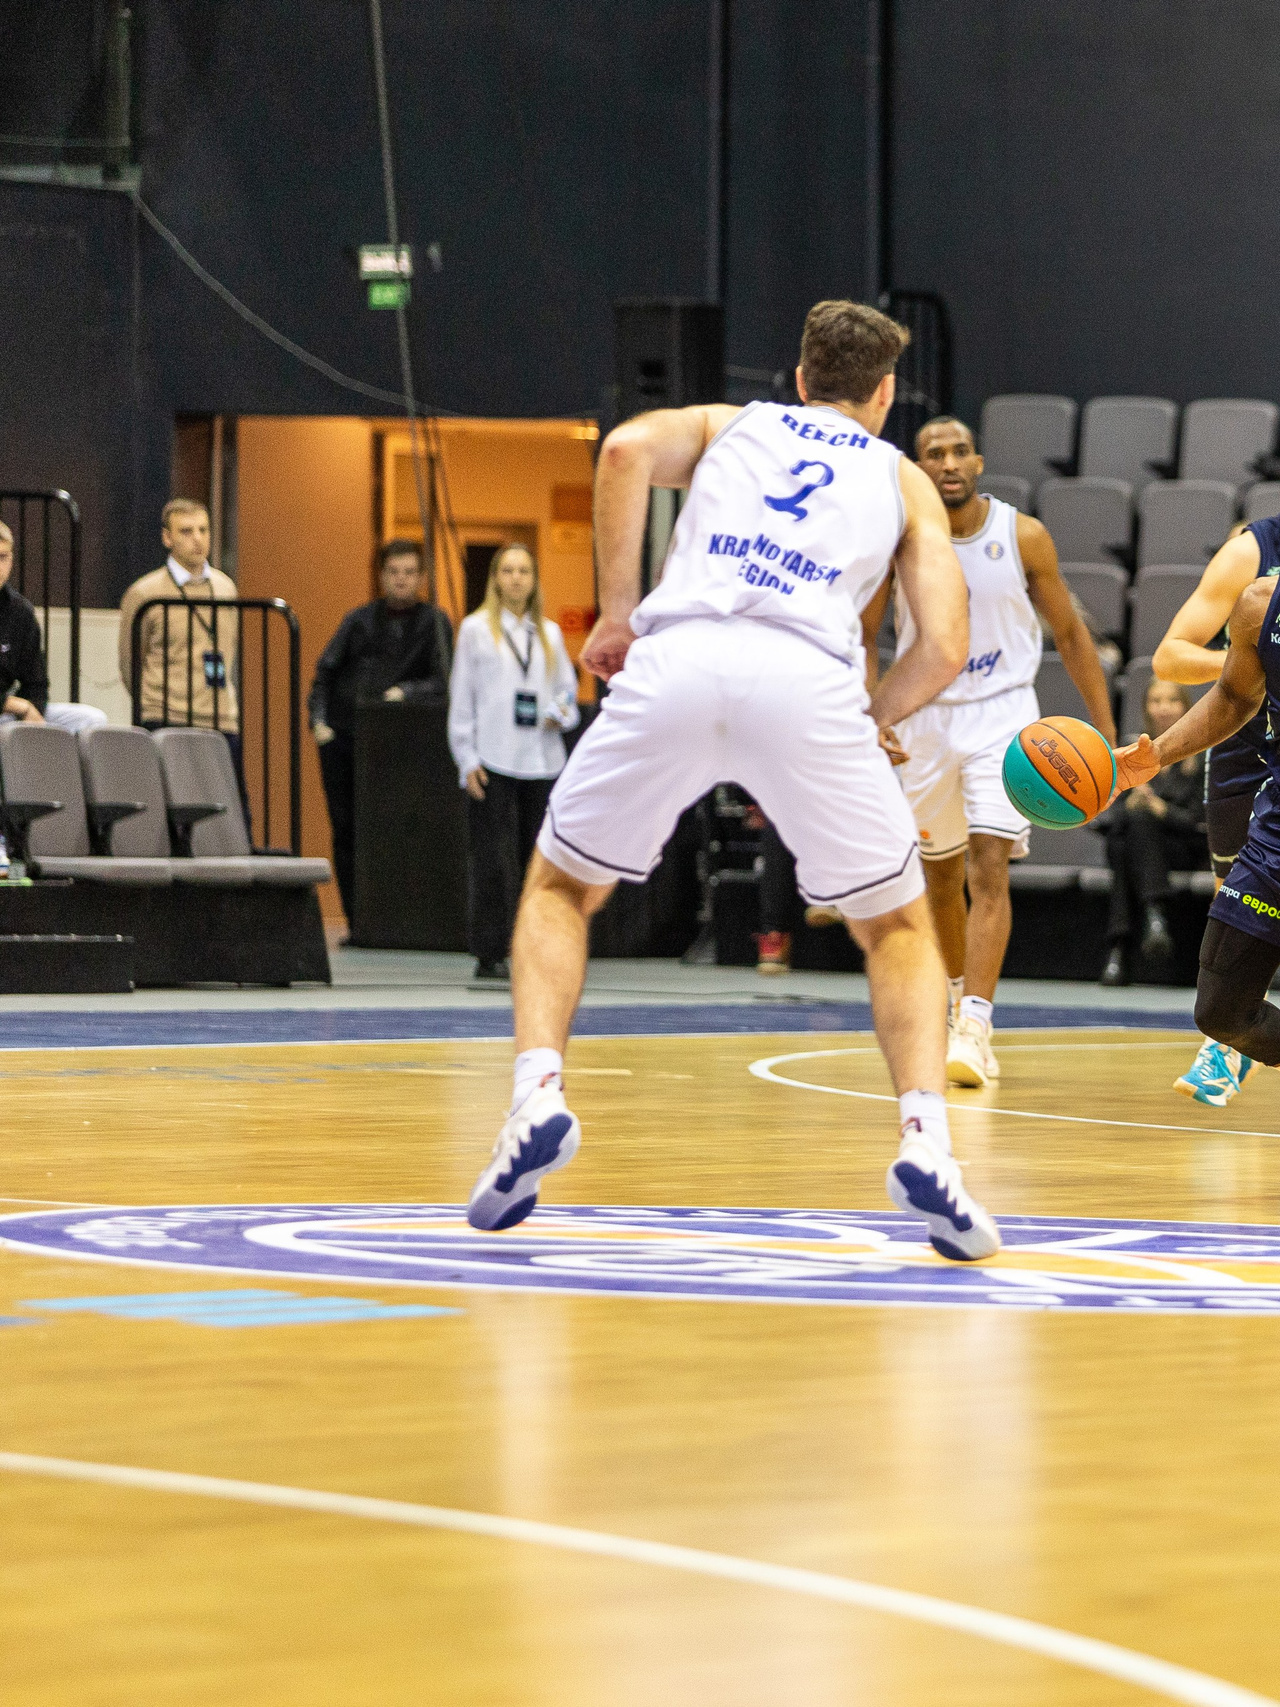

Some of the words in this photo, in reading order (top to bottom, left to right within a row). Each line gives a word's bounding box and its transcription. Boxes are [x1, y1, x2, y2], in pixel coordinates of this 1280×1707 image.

[764, 459, 835, 522] 2
[707, 532, 842, 587] KRANOYARSK
[738, 558, 796, 596] EGION
[967, 648, 1002, 677] sey
[1219, 884, 1241, 899] mpa
